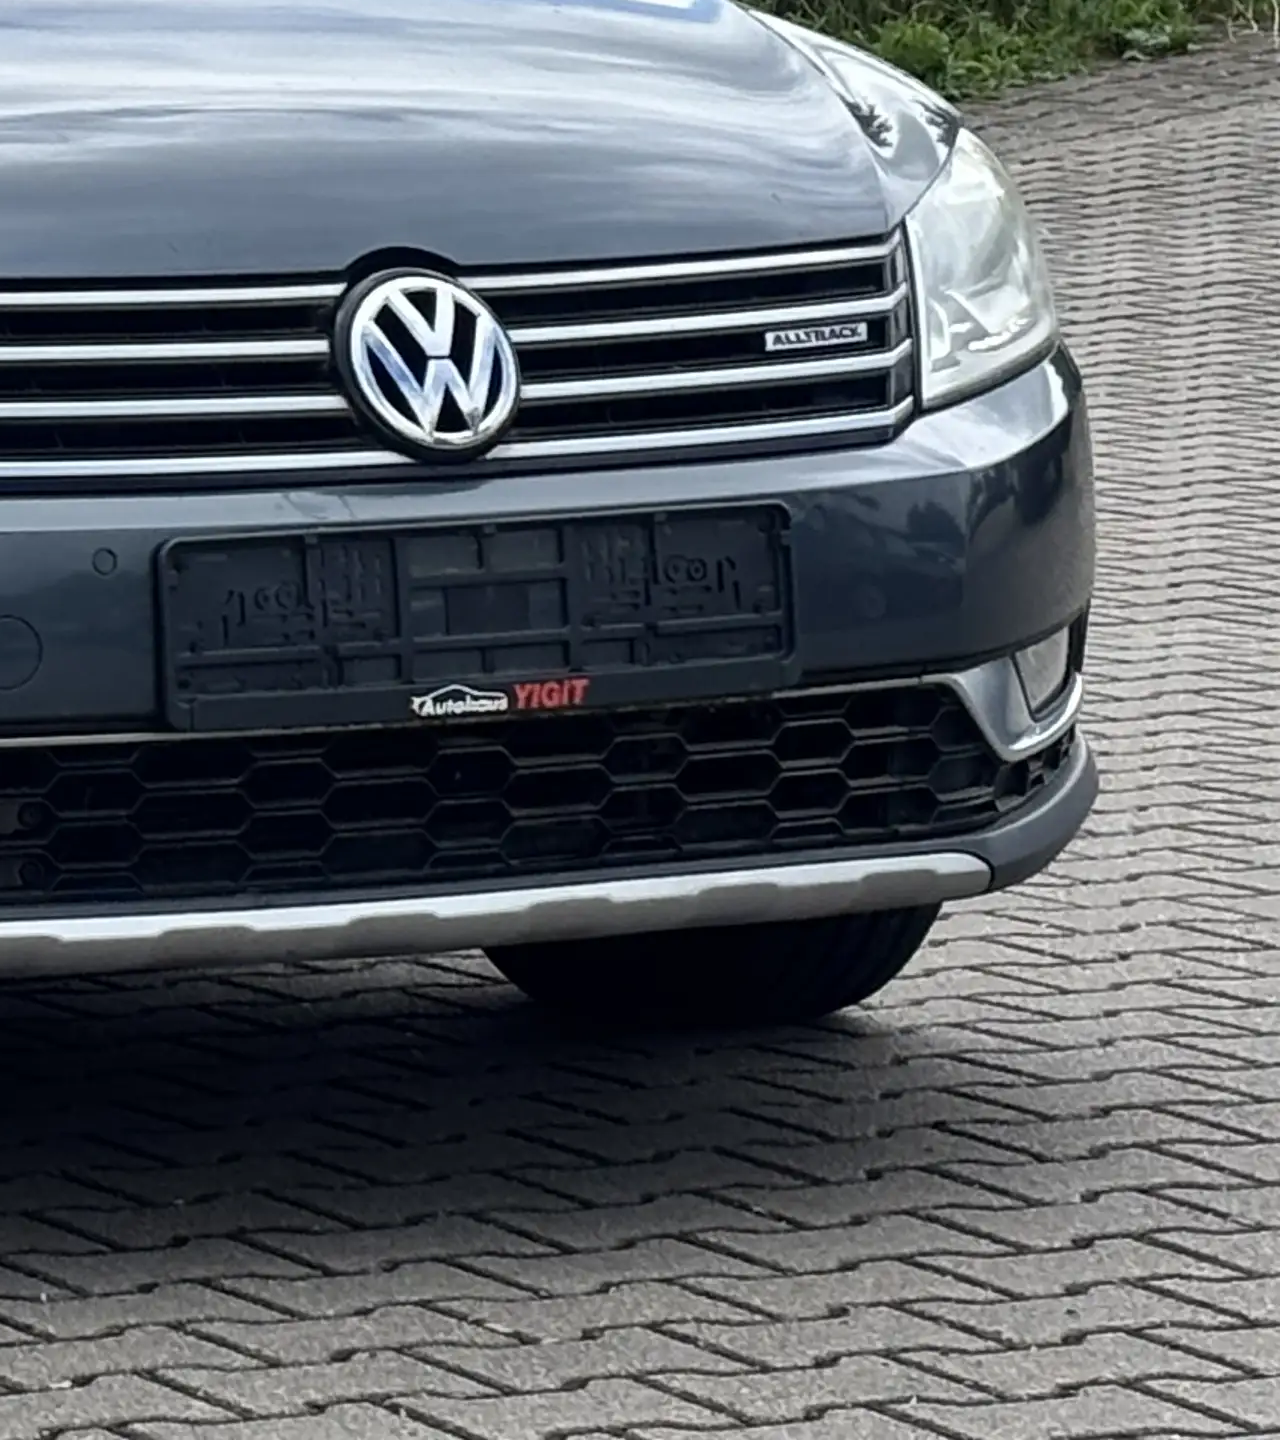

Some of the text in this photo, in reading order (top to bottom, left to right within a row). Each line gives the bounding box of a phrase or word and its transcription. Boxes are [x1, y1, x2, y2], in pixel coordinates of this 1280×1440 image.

[771, 325, 861, 347] ALLTRACK
[351, 276, 517, 449] VW
[513, 679, 590, 709] YIGIT
